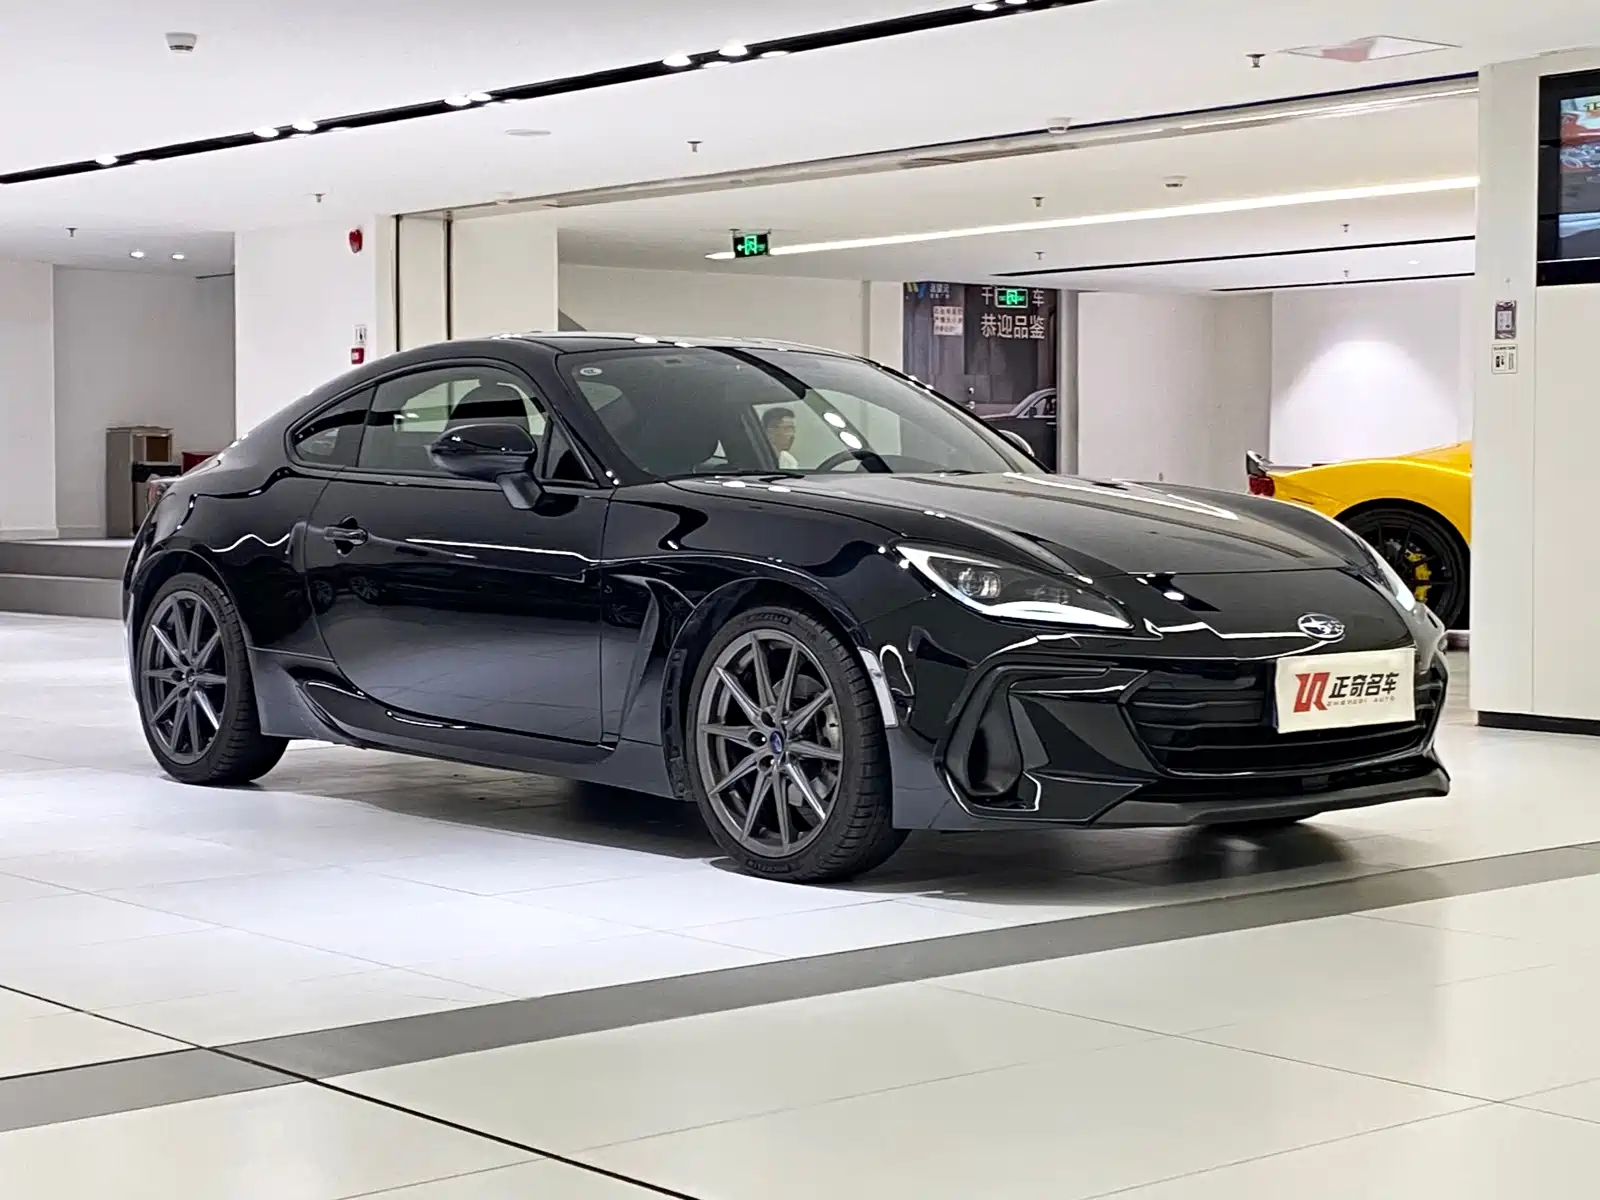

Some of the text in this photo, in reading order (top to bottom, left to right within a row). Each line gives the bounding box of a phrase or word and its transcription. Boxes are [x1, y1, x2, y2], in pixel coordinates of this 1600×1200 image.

[980, 313, 1045, 339] 恭迎品鉴
[1328, 672, 1400, 698] 正奇名车
